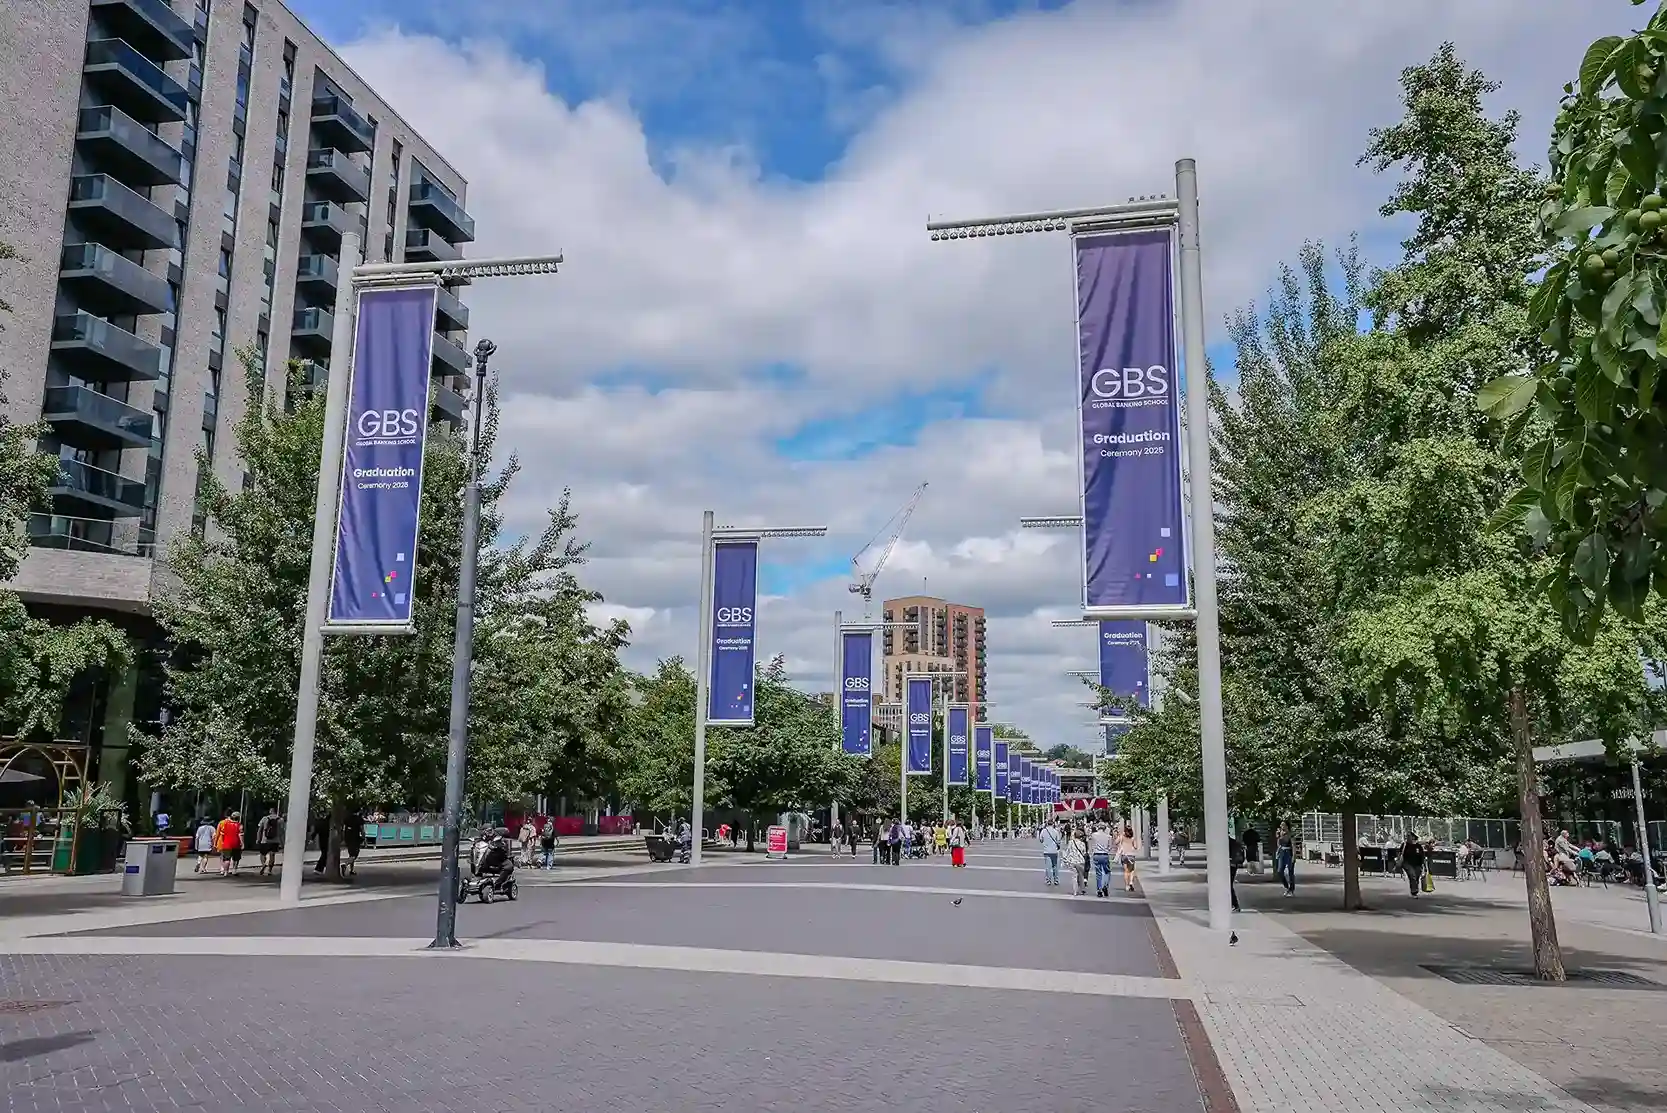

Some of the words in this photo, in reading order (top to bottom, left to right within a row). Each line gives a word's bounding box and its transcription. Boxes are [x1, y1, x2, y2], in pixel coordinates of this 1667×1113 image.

[1091, 365, 1168, 397] GBS
[358, 408, 418, 437] GBS
[1093, 430, 1170, 444] Graduation
[1100, 449, 1143, 457] Ceremony
[1143, 446, 1164, 455] 2025
[353, 466, 415, 478] Graduation
[357, 481, 392, 490] Ceremony
[717, 607, 752, 622] GBS
[845, 677, 870, 688] GBS
[910, 713, 930, 722] GBS
[950, 735, 966, 743] GBS
